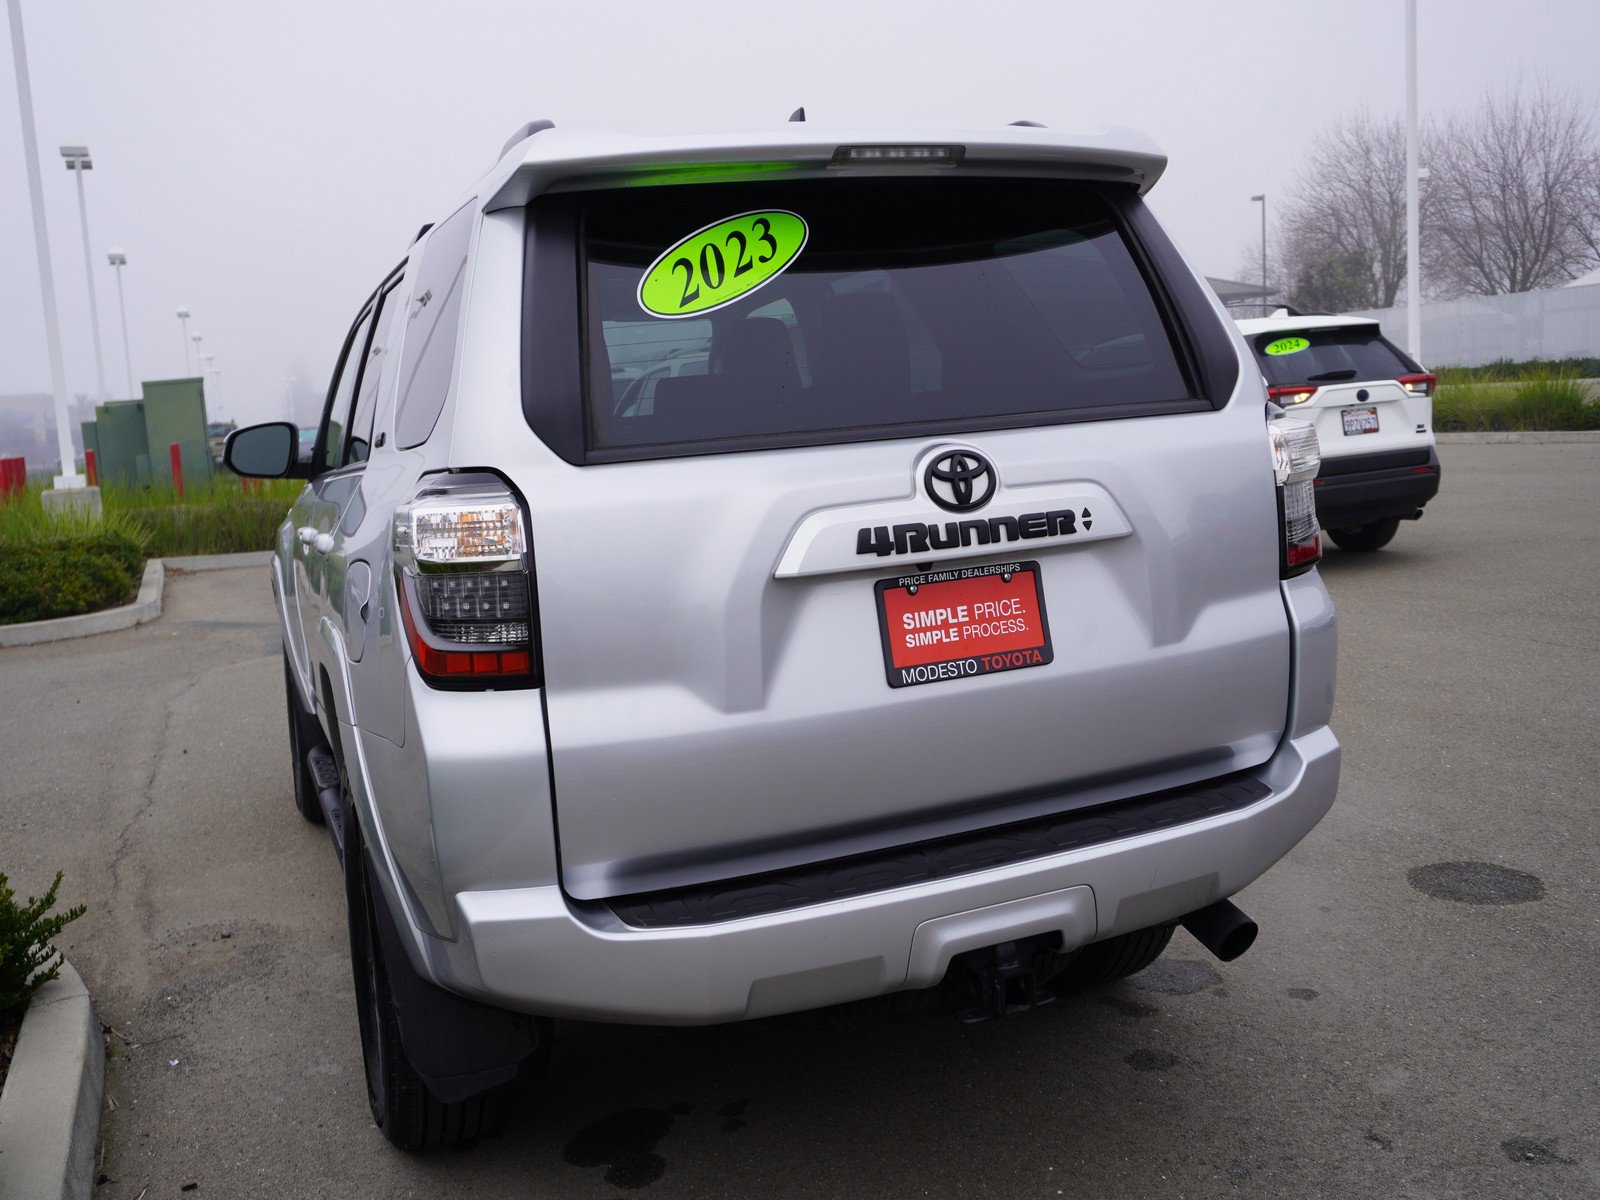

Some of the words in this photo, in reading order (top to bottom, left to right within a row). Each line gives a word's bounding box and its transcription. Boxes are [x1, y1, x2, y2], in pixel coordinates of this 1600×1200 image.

[672, 217, 777, 308] 2023
[1274, 339, 1301, 354] 2024
[856, 509, 1077, 557] 4RUNNER
[899, 575, 926, 587] PRICE
[928, 571, 959, 583] FAMILY
[961, 563, 1021, 578] DEALERSHIPS
[902, 605, 969, 630] SIMPLE
[973, 598, 1026, 619] PRICE.
[905, 627, 960, 648] SIMPLE
[963, 618, 1029, 640] PROCESS.
[902, 659, 978, 684] MODESTO
[981, 649, 1043, 671] TOYOTA
